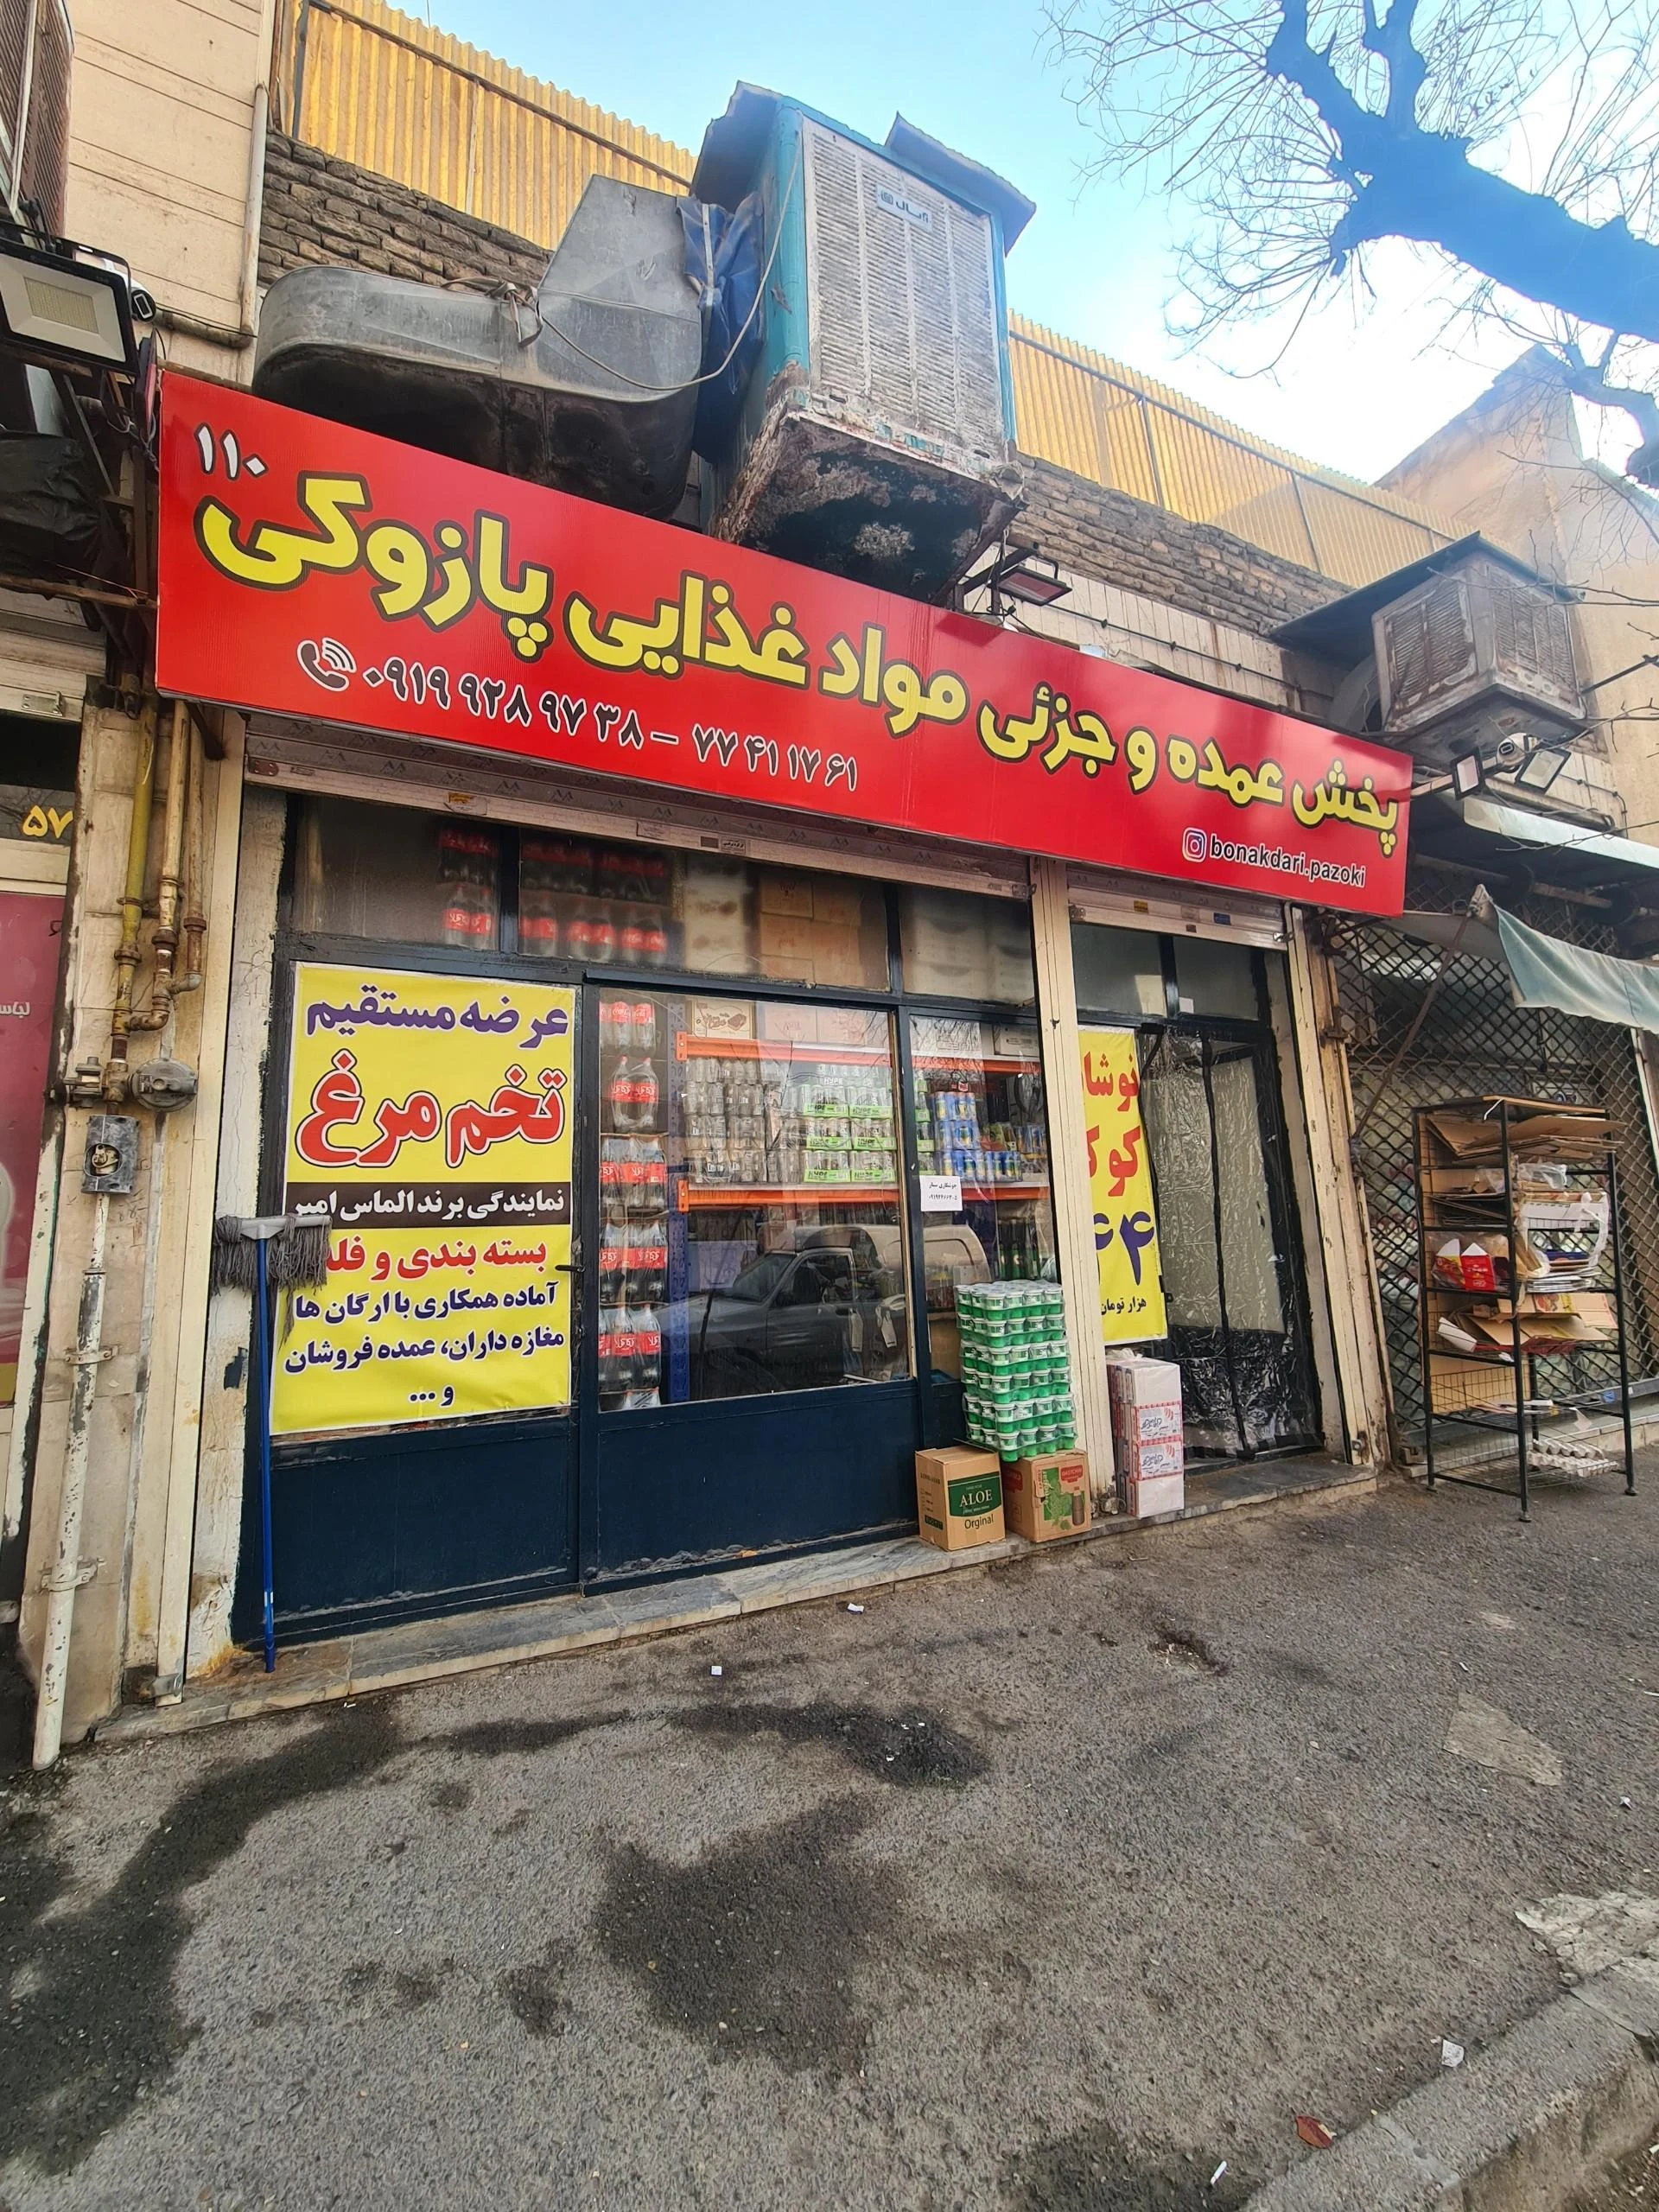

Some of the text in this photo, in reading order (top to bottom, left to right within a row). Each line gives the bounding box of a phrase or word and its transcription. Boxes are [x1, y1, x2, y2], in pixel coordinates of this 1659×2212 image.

[194, 422, 269, 480] ۱۱۰
[194, 469, 1400, 857] پخش عمده و جزئی مواد غذایی پازوکی
[22, 804, 73, 839] ۵۷
[1210, 833, 1365, 888] bonakdari.pazoki
[307, 985, 569, 1048] عرضه مستقیم
[1083, 1051, 1140, 1112] نوشا
[296, 1048, 567, 1168] تخم مرغ
[340, 1189, 413, 1221] الماس
[416, 1190, 465, 1221] برند
[467, 1188, 564, 1218] نمایندگی
[371, 1251, 391, 1281] و
[397, 1240, 476, 1279] بندی
[483, 1239, 548, 1273] بسته
[296, 1281, 559, 1324] آماده همکاری با ارگان ها
[1128, 1296, 1147, 1313] هزار
[284, 1336, 373, 1373] فروشان
[378, 1339, 435, 1359] عمده
[511, 1326, 565, 1356] مغازه
[959, 1489, 993, 1507] ALOE
